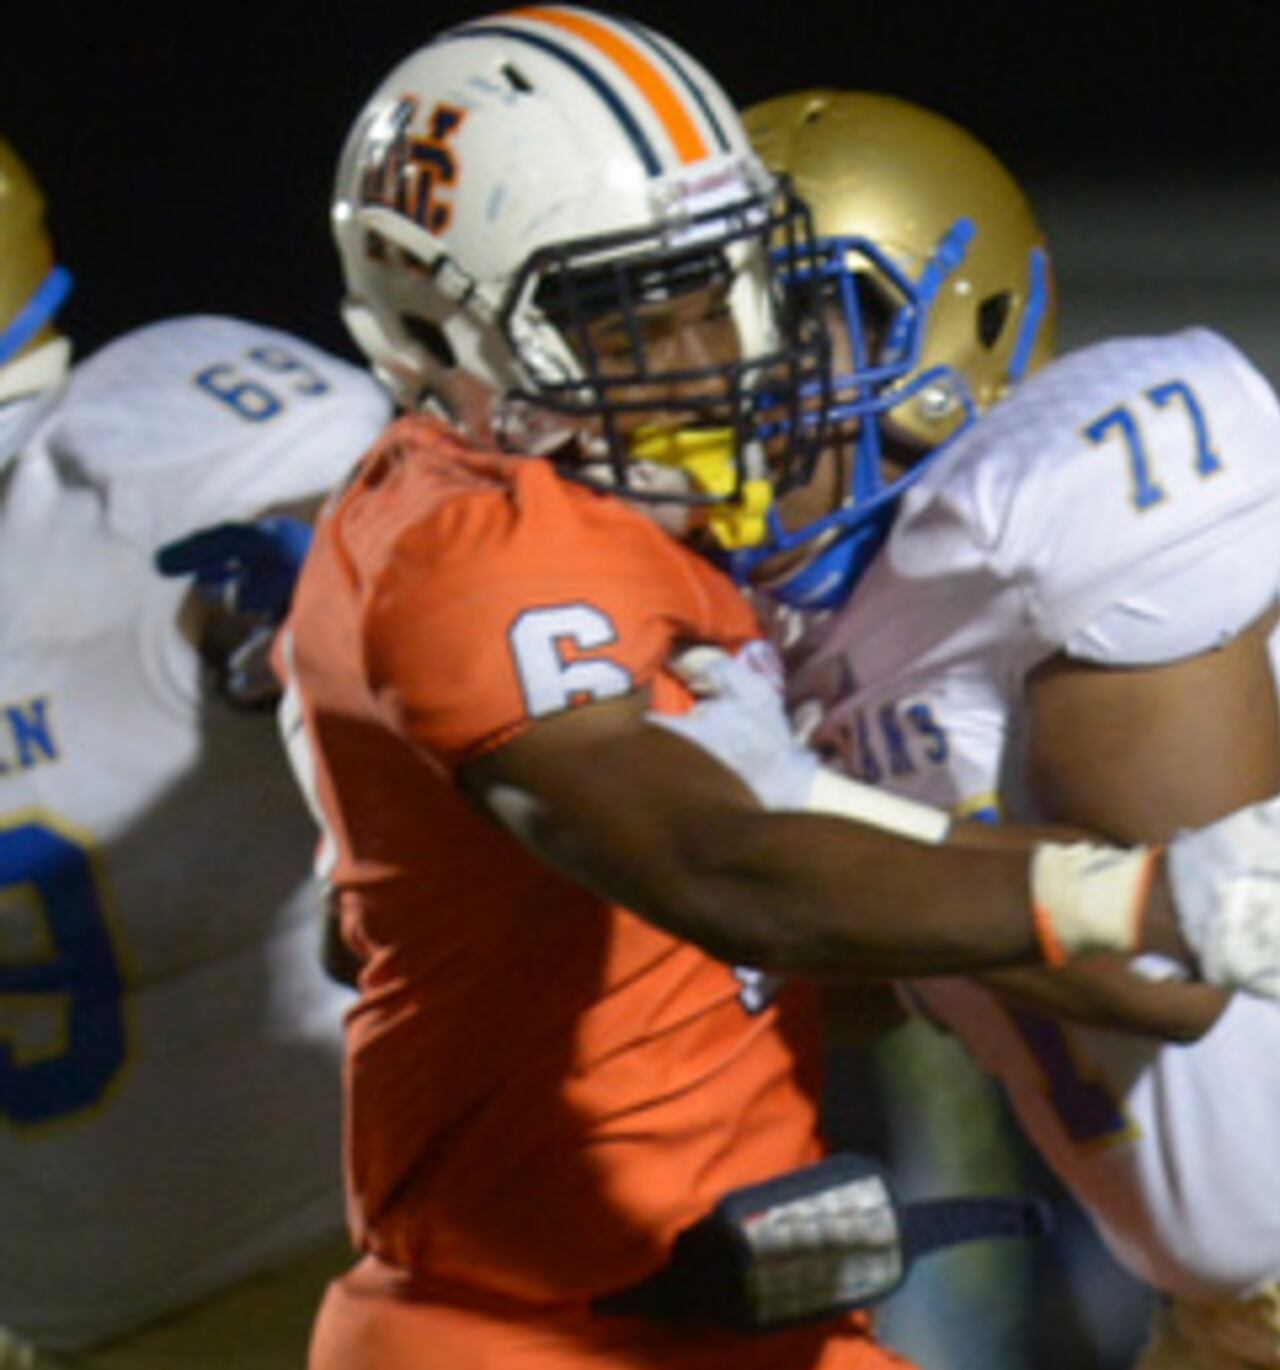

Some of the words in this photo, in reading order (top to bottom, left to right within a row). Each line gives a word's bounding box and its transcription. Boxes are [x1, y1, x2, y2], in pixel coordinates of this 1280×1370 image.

[192, 345, 333, 423] 69
[1079, 377, 1222, 512] 77
[507, 601, 635, 724] 6
